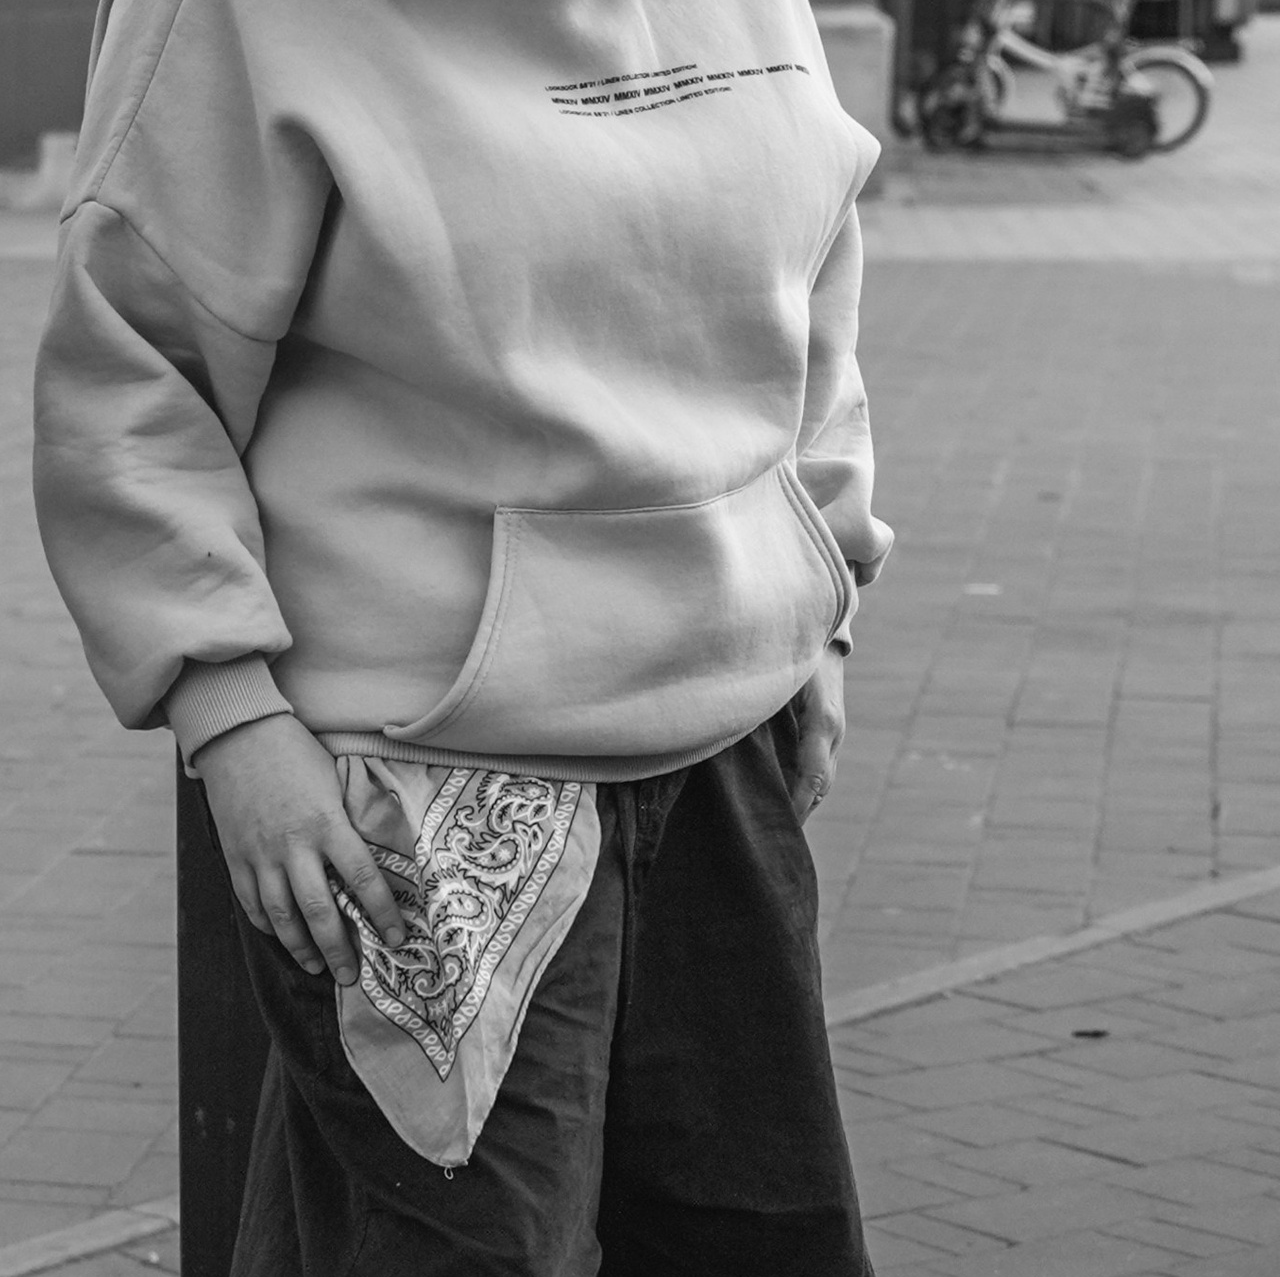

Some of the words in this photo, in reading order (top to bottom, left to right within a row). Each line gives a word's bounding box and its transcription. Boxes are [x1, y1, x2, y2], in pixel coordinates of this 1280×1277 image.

[581, 94, 611, 105] MMXIV
[614, 88, 641, 101] MMXIV
[643, 85, 671, 96] MMXIV
[673, 76, 704, 89] MMXIV
[706, 71, 735, 81] MMXIV
[737, 68, 764, 77] MMXIV
[766, 63, 793, 74] MMXIV
[634, 98, 676, 113] COLLECTION
